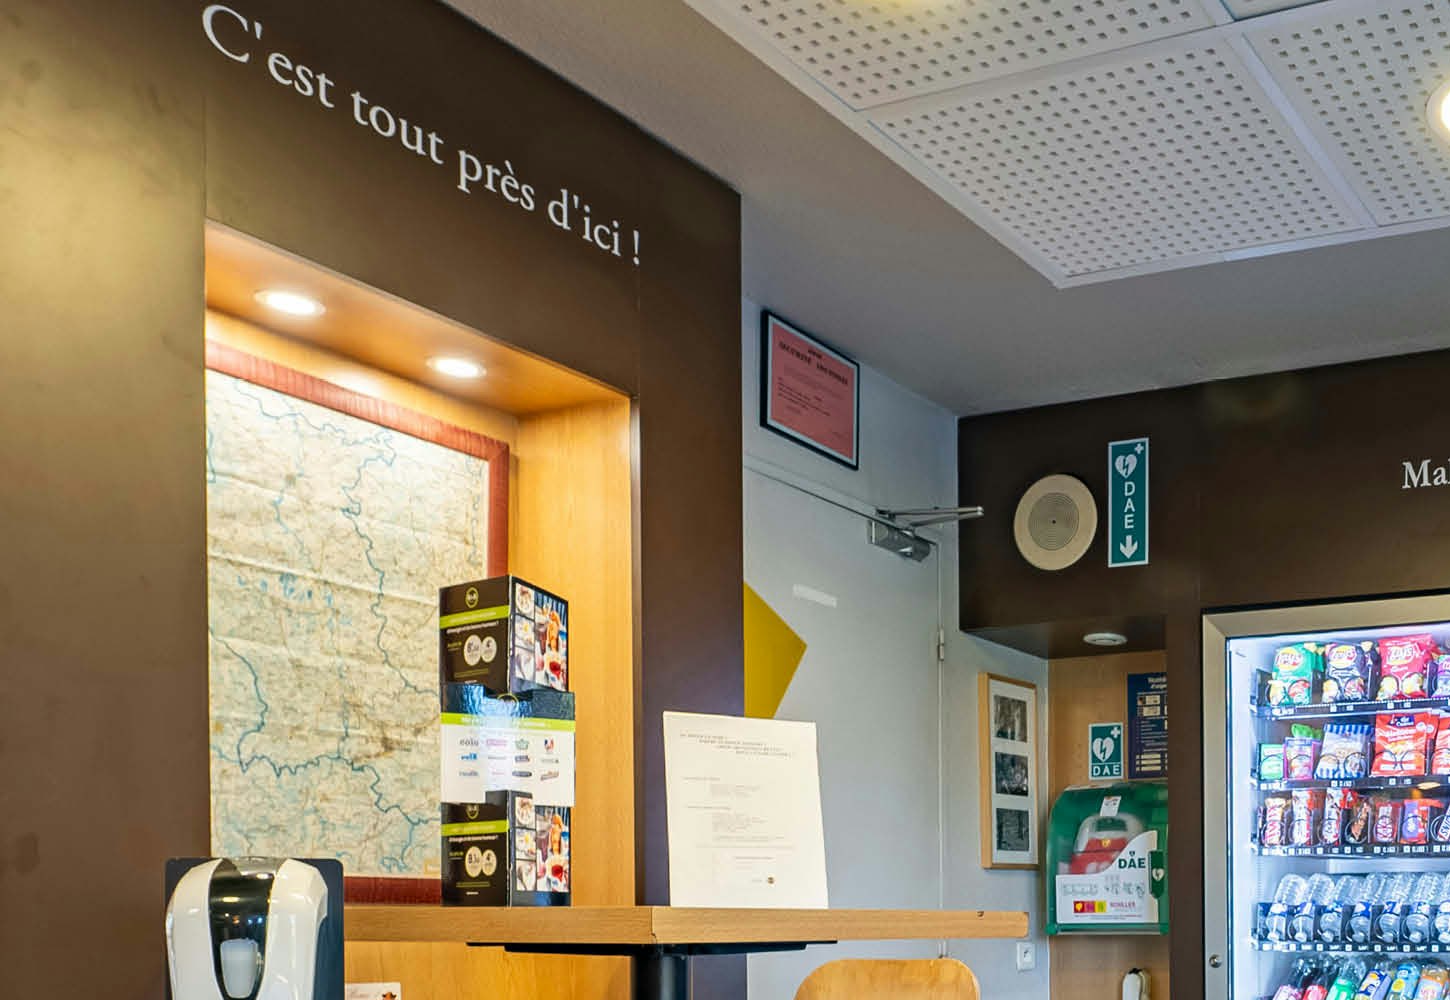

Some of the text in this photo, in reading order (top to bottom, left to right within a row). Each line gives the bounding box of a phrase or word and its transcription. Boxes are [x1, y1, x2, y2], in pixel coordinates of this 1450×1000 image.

[202, 4, 642, 266] C'est tout près d'ici !
[1123, 480, 1136, 529] DAE
[1092, 764, 1122, 776] DAE
[1118, 857, 1147, 869] DAE
